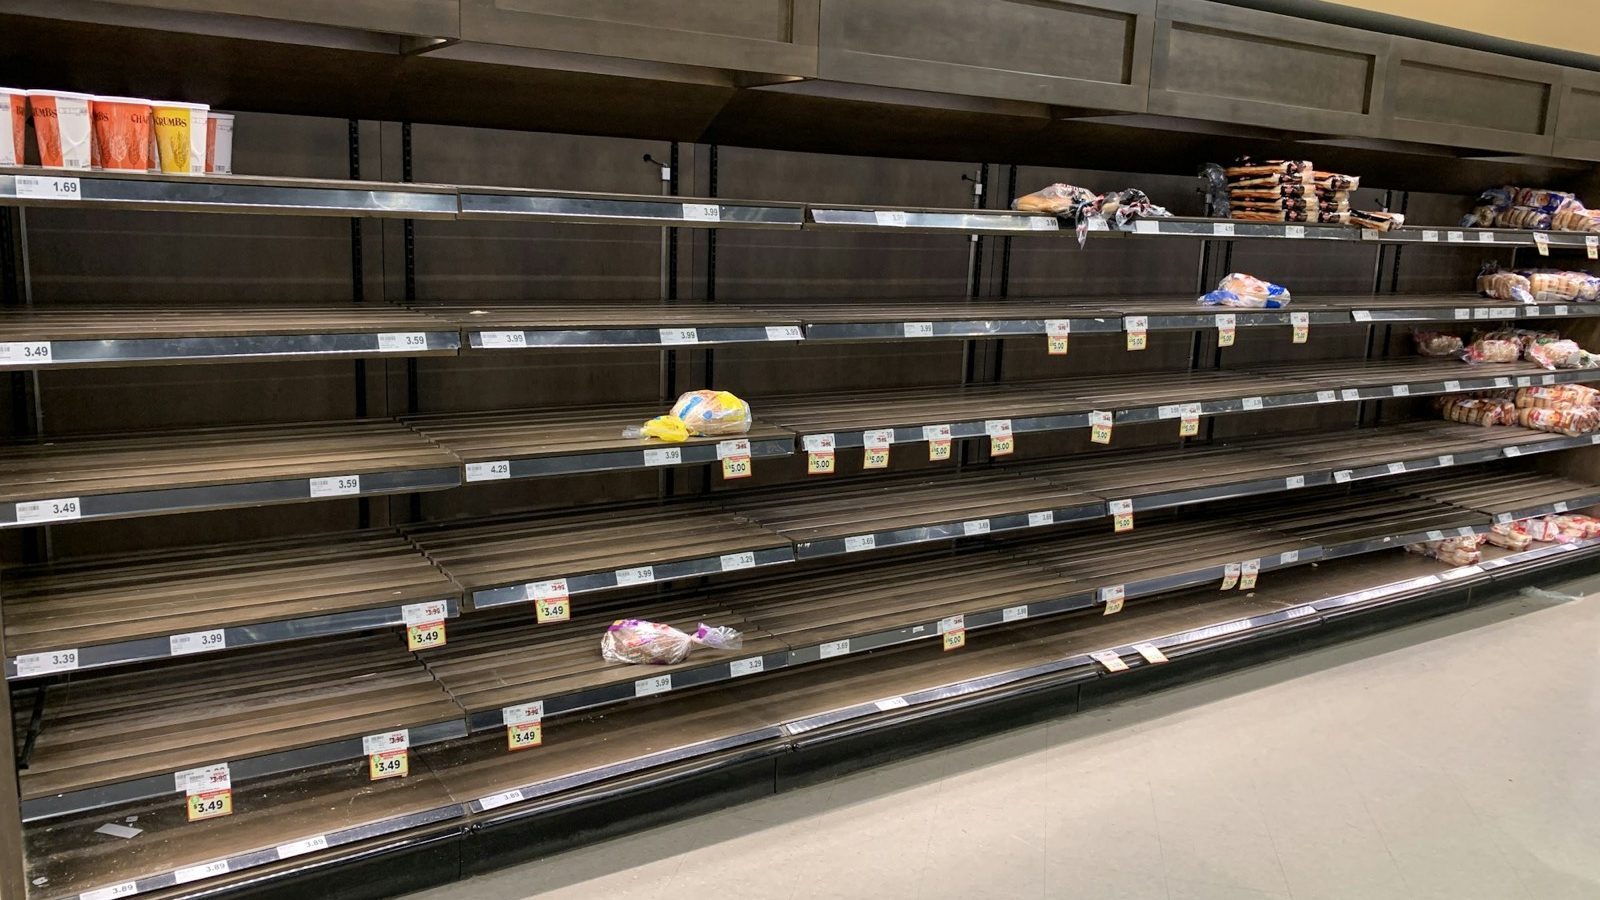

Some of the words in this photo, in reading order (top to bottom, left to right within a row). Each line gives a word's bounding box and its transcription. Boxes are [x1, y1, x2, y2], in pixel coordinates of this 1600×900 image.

[53, 182, 77, 193] 1.69
[704, 207, 718, 216] 3.99
[406, 336, 424, 345] 3.59
[506, 335, 524, 343] 3.99
[681, 331, 695, 340] 3.99
[24, 347, 48, 357] 3.49
[665, 451, 680, 460] 3.99
[491, 465, 508, 474] 4.29
[338, 479, 357, 489] 3.59
[53, 503, 76, 514] 3.49
[638, 569, 652, 579] 3.99
[541, 606, 564, 616] $3.49
[202, 634, 223, 645] 3.99
[413, 631, 439, 643] $3.49
[53, 654, 75, 665] 3.39
[750, 661, 763, 669] 3.29
[656, 677, 669, 687] 3.99
[513, 731, 536, 742] $3.49
[375, 760, 401, 771] $3.49
[505, 792, 520, 801] 3.89
[194, 800, 224, 812] $3.49
[306, 838, 325, 848] 3.89
[206, 861, 226, 873] 3.89
[112, 884, 133, 894] 3.89
